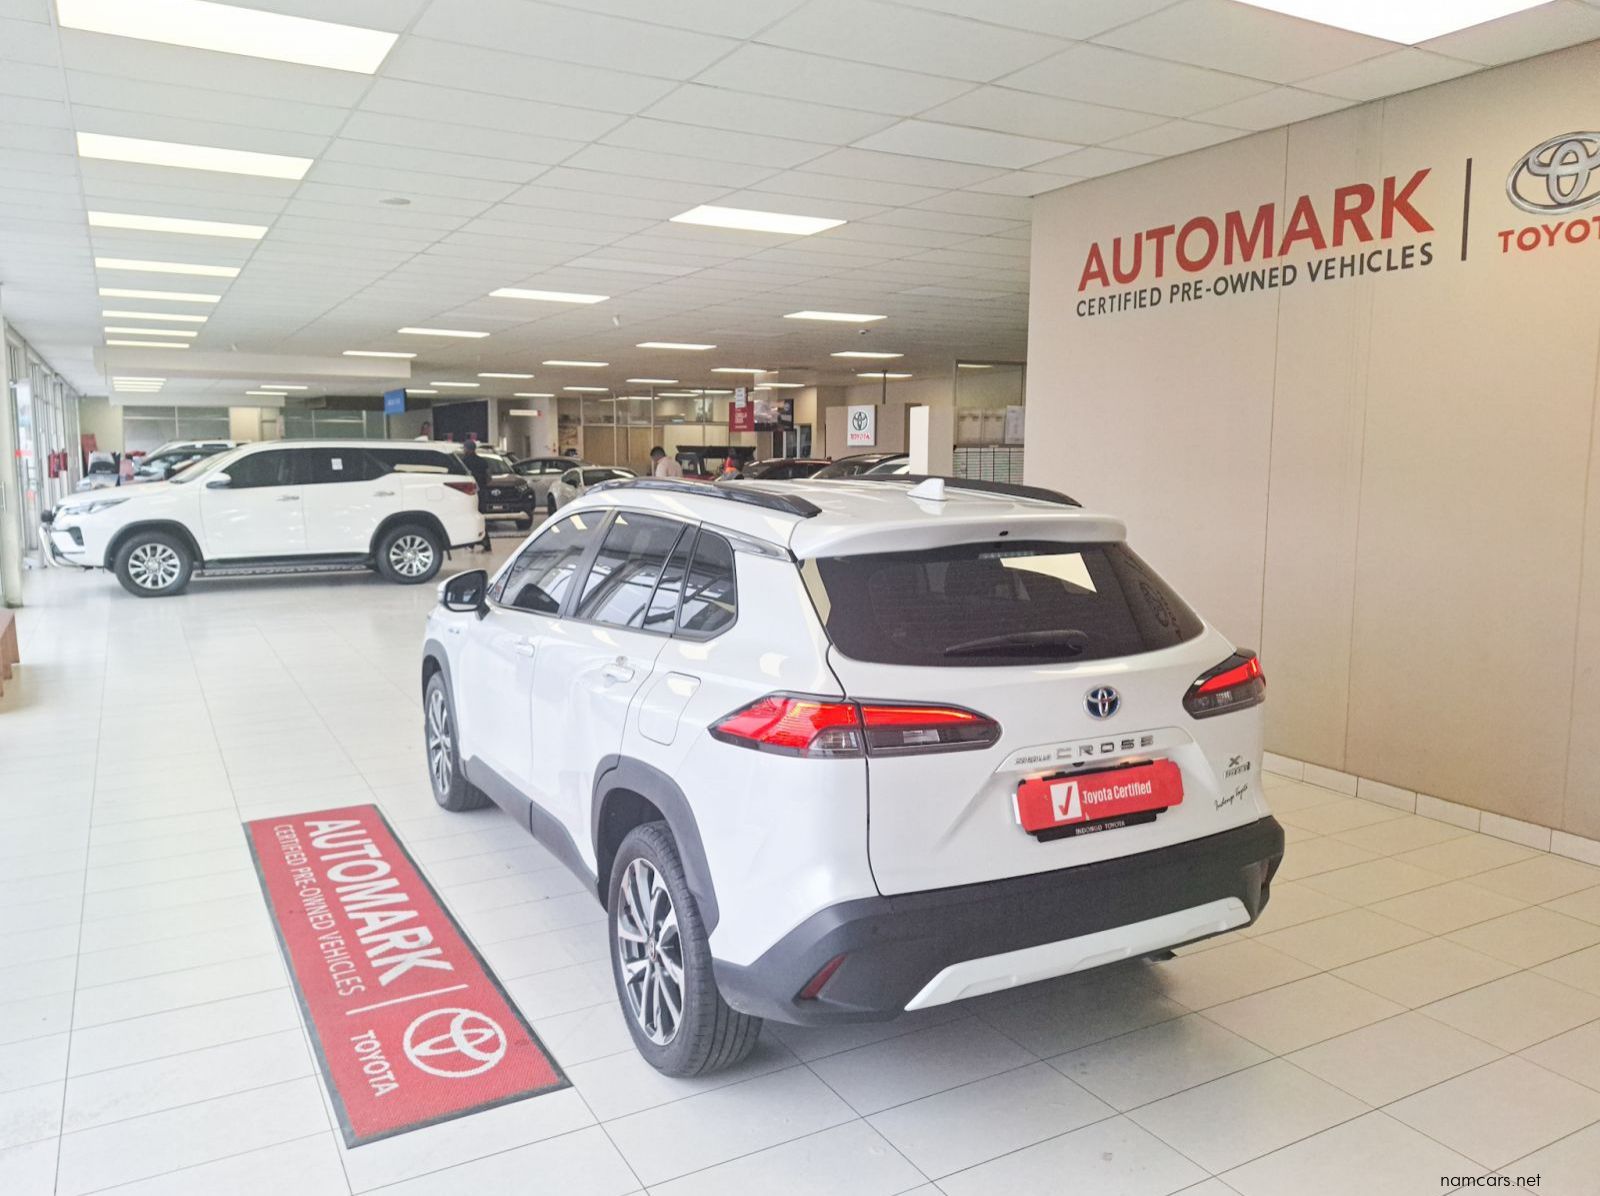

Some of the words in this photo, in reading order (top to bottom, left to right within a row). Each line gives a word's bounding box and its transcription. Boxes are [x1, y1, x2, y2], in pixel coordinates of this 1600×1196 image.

[1077, 167, 1435, 292] AUTOMARK
[1076, 286, 1162, 317] CERTIFIED
[1169, 264, 1298, 305] PRE-OWNED
[1306, 242, 1434, 283] VEHICLES
[1056, 735, 1154, 760] CROSS
[1082, 787, 1113, 804] Toyota
[1113, 780, 1152, 800] Certified
[273, 823, 308, 866] CERTIFIED
[290, 866, 336, 931] PRE-OWNED
[303, 819, 454, 987] AUTOMARK
[318, 930, 366, 996] VEHICLES
[350, 1029, 399, 1097] TOYOTA
